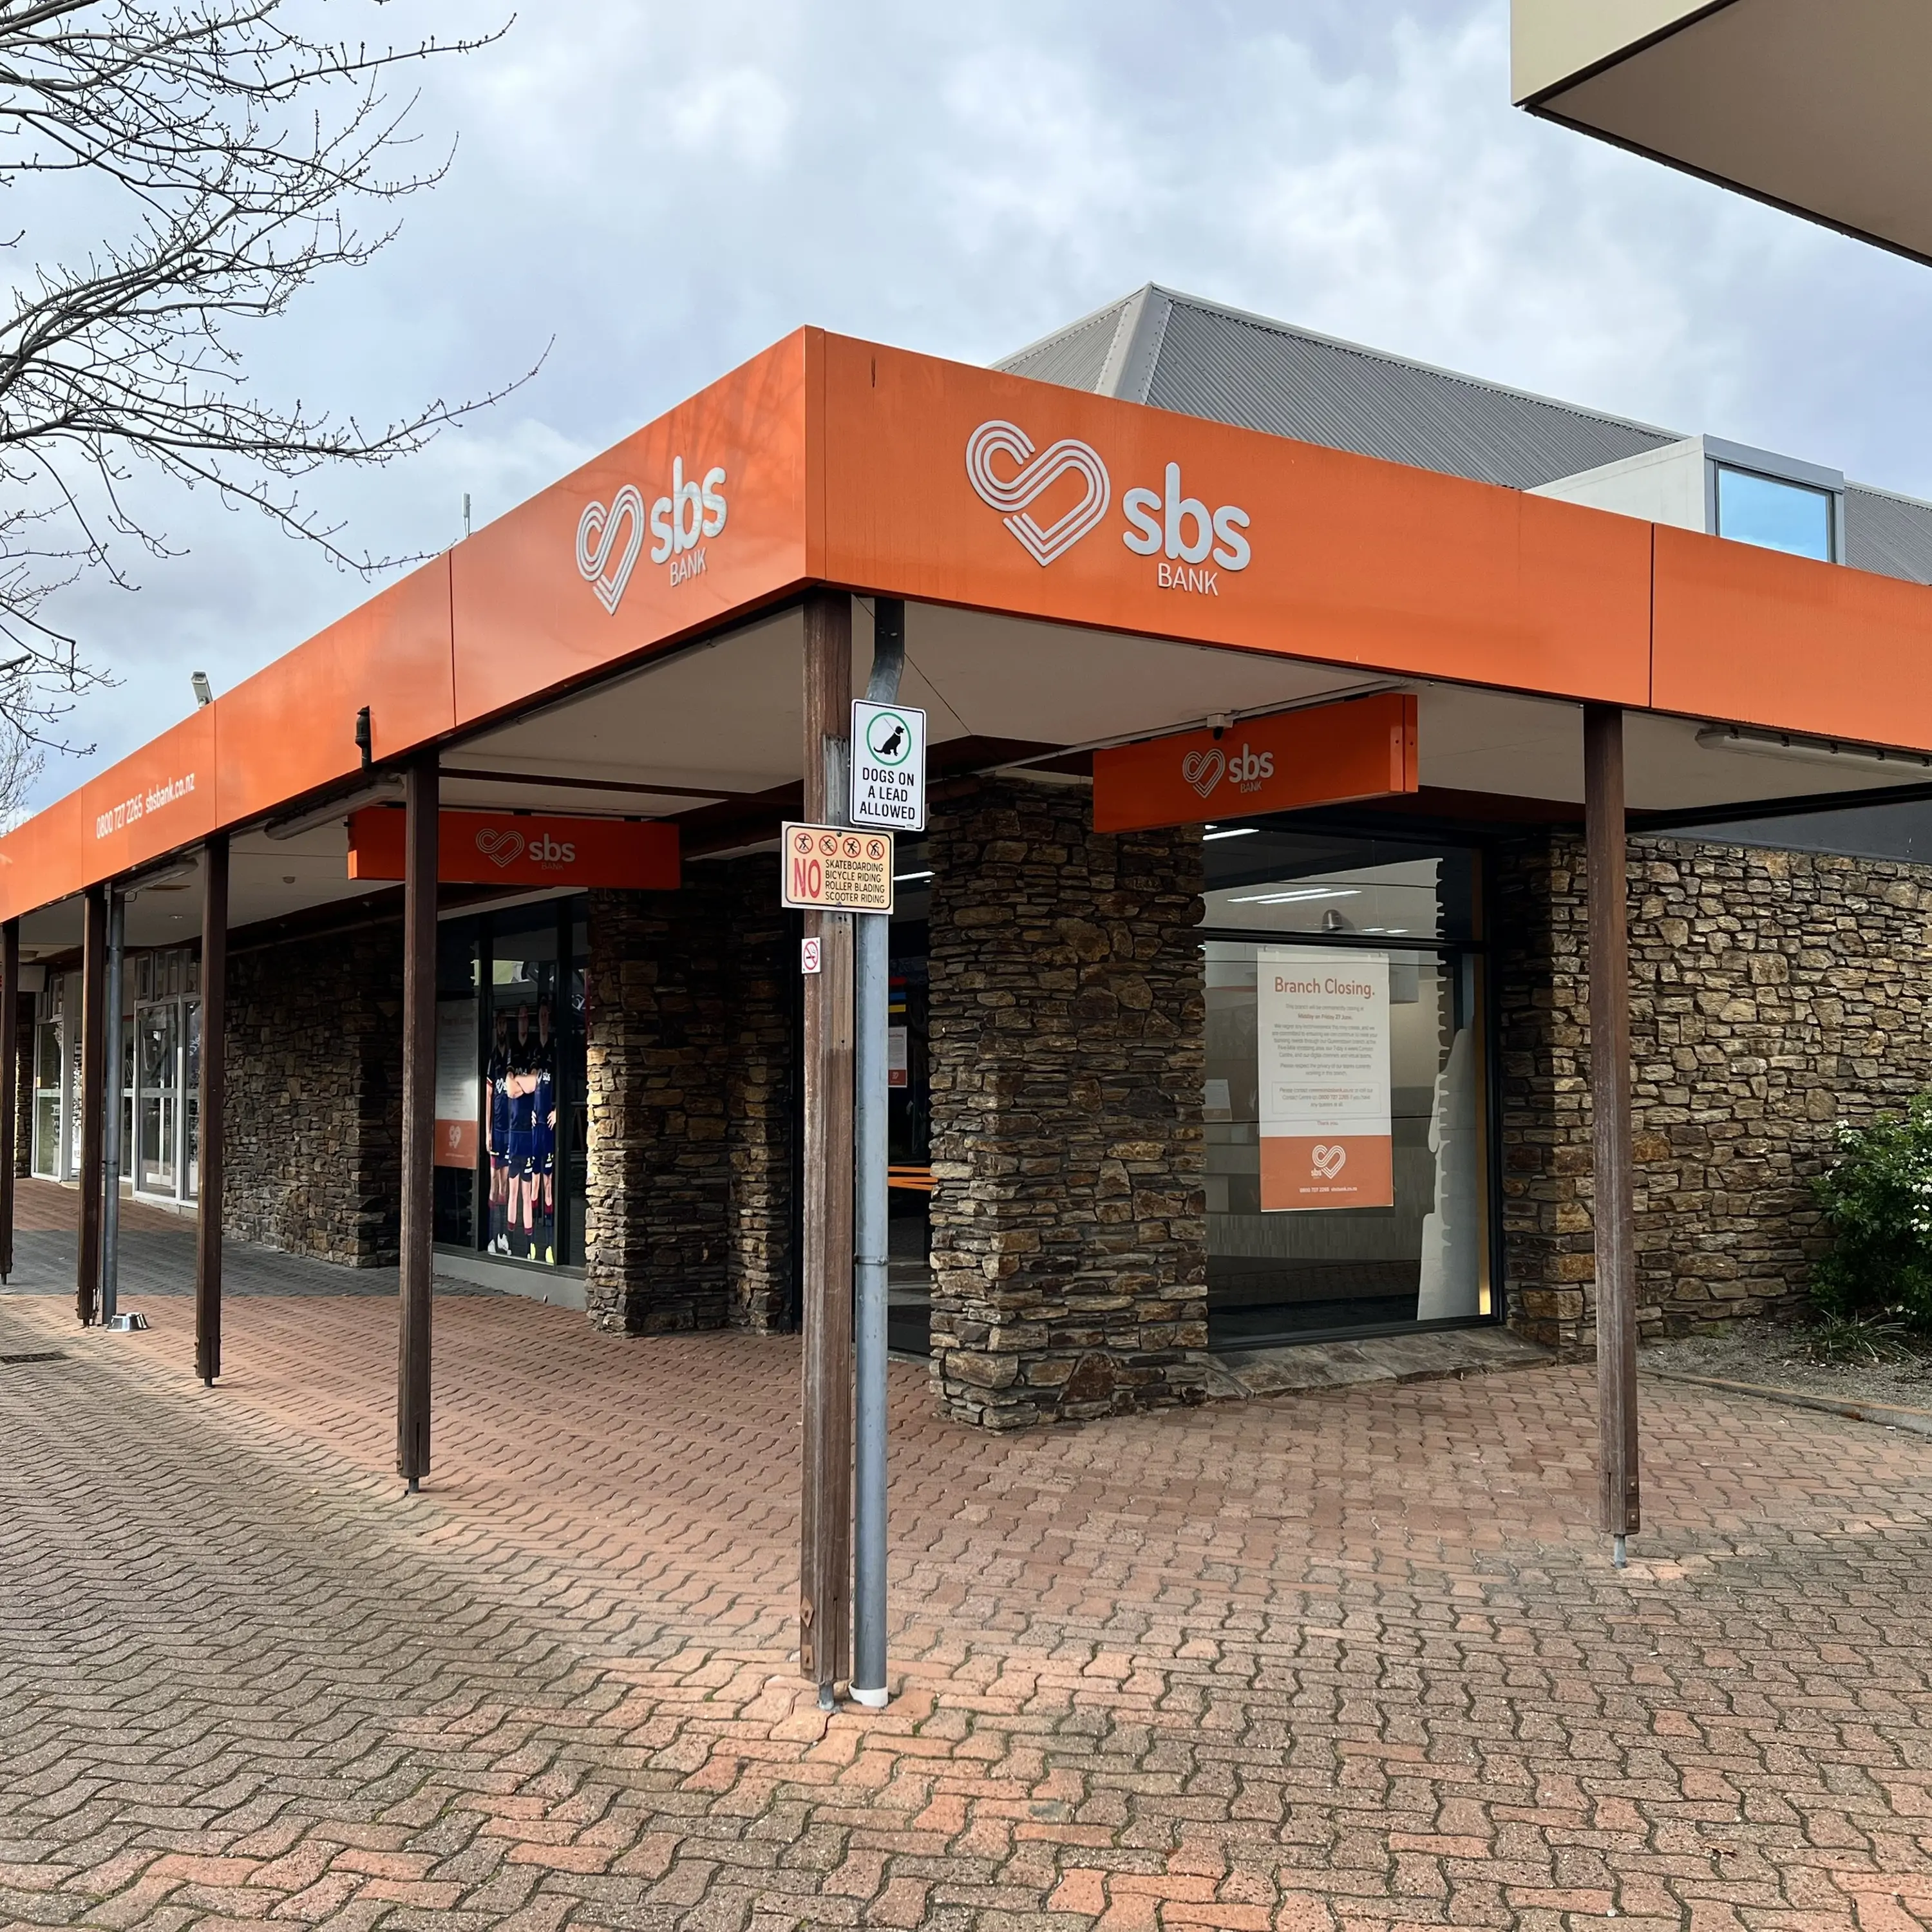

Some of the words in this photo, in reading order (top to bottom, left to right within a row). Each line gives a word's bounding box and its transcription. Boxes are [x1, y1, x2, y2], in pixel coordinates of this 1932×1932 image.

[650, 455, 727, 564] sbs
[1122, 462, 1251, 571] sbs
[670, 547, 707, 587] BANK
[1157, 562, 1218, 596] BANK
[1229, 743, 1274, 783] sbs
[862, 767, 895, 784] DOGS
[898, 772, 914, 786] ON
[1240, 781, 1262, 793] BANK
[867, 785, 875, 799] A
[879, 786, 907, 802] LEAD
[96, 810, 113, 839] 0800
[113, 803, 126, 830] 727
[126, 793, 143, 824] 2265
[145, 773, 194, 814] sbsbank.co.nz
[860, 801, 915, 820] ALLOWED
[529, 833, 576, 862] sbs
[825, 859, 884, 872] SKATEBOARDING
[825, 870, 855, 881] BICYCLE
[857, 873, 882, 883] RIDING
[794, 858, 821, 898] NO
[825, 881, 853, 891] ROLLER
[854, 883, 885, 893] BLADING
[825, 891, 858, 902] SCOOTER
[860, 893, 885, 904] RIDING
[1274, 976, 1320, 994] Branch
[1325, 978, 1375, 999] Closing.
